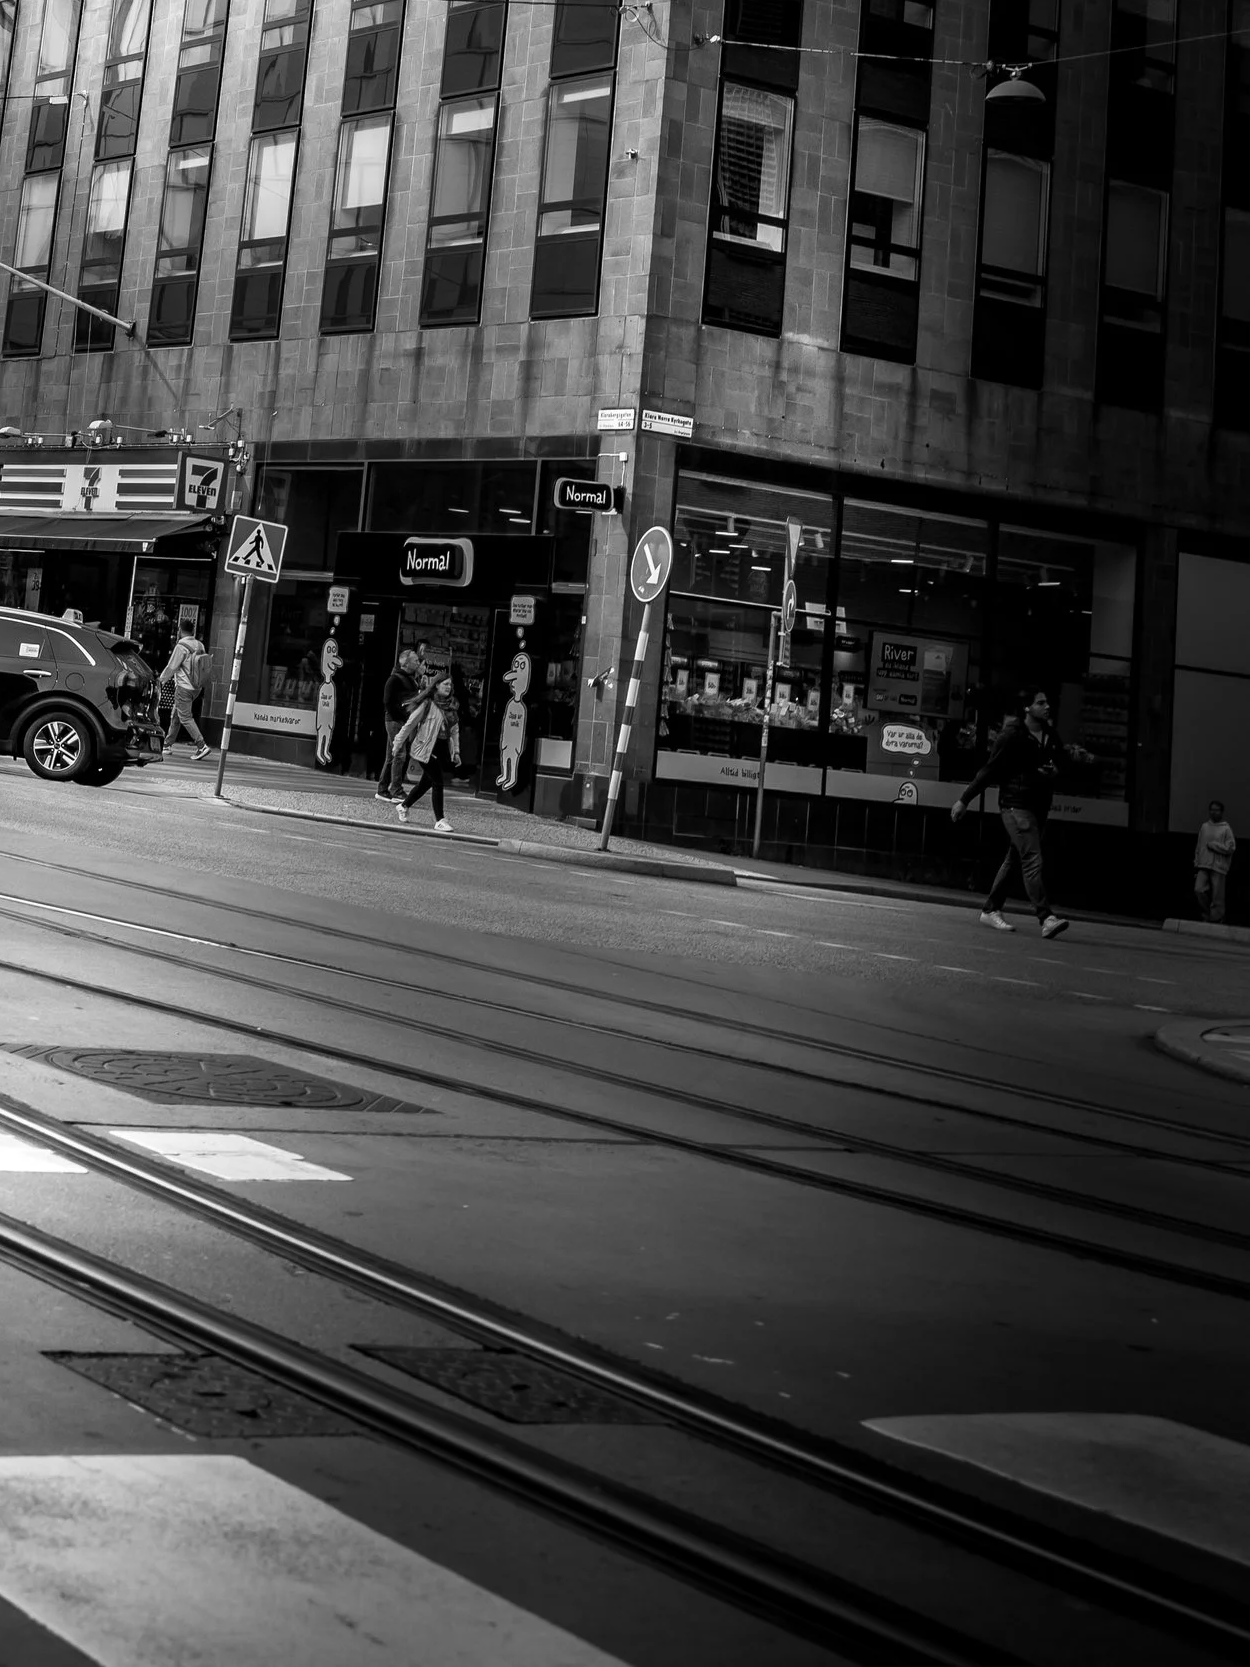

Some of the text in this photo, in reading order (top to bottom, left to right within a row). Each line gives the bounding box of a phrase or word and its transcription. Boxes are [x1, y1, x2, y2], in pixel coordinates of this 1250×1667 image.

[566, 484, 607, 505] Normal
[406, 548, 450, 571] Normal
[885, 644, 915, 661] River
[887, 730, 897, 738] Var
[719, 766, 739, 778] Alltid
